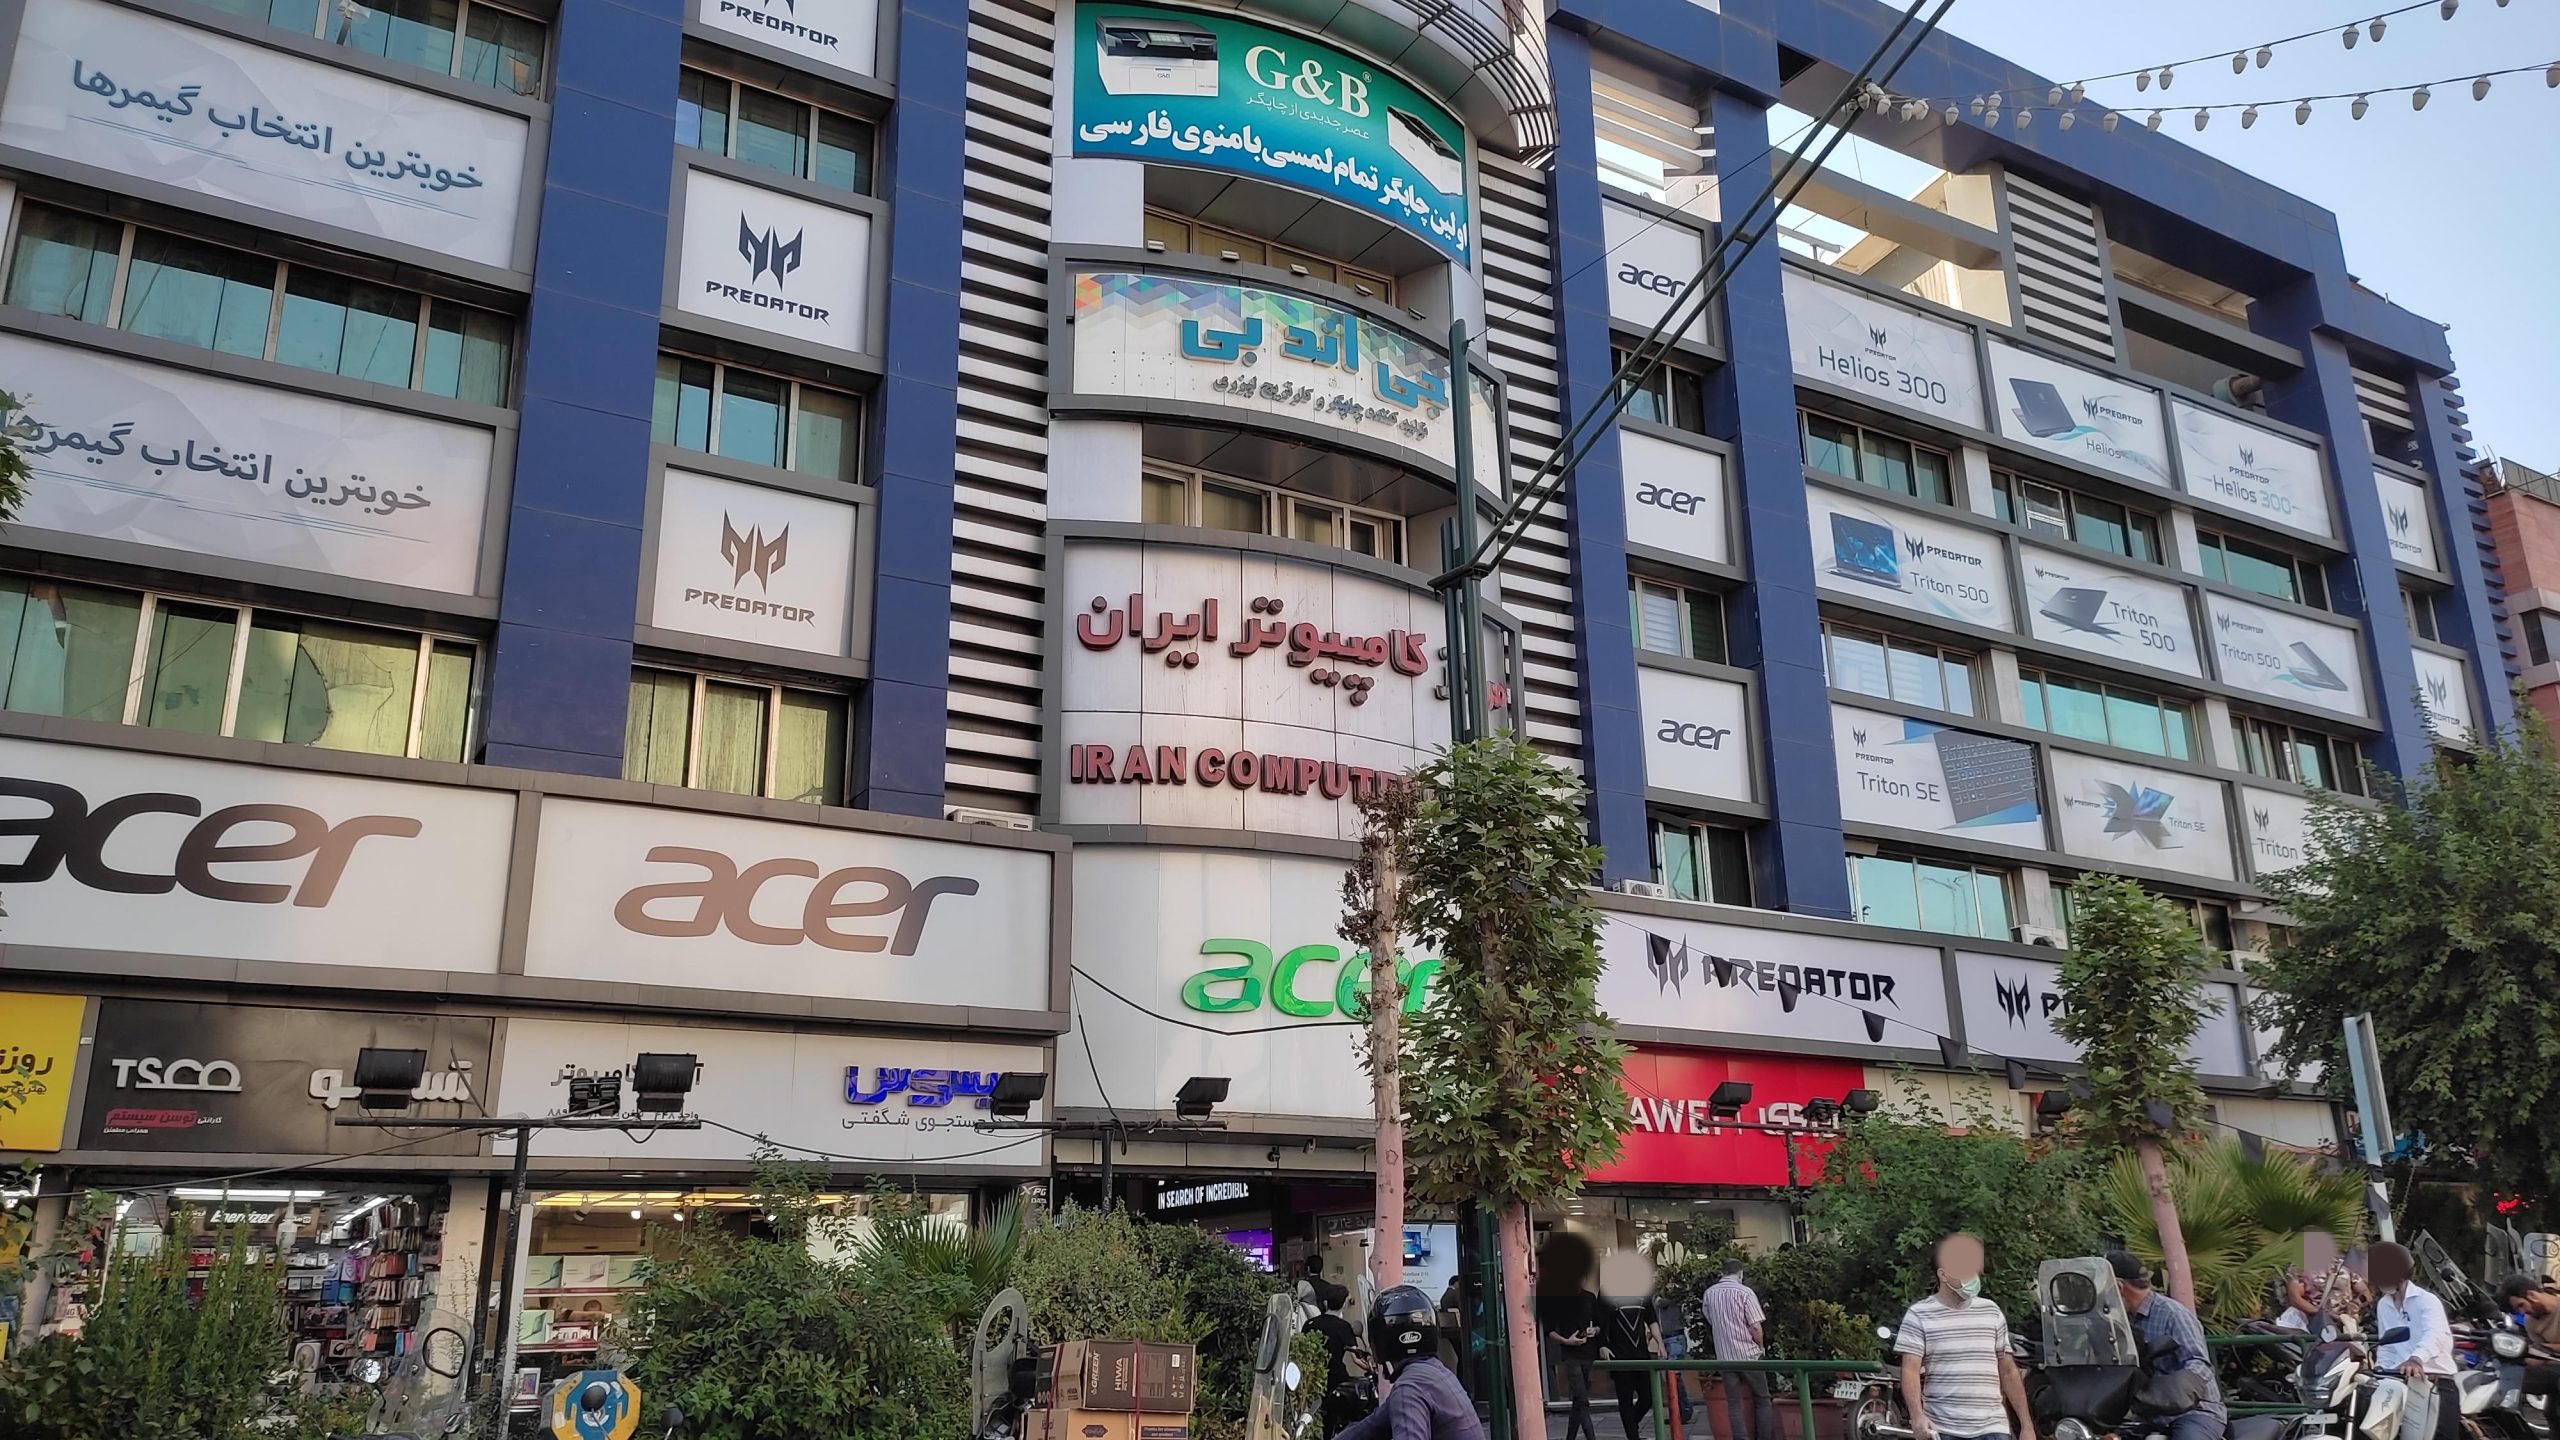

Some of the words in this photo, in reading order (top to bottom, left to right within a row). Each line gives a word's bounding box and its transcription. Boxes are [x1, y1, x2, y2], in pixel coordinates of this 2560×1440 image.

[720, 0, 839, 53] PREDATOR
[73, 60, 201, 122] گیمرها
[1246, 92, 1288, 115] چاپگر
[208, 107, 332, 154] انتخاب
[1080, 110, 1172, 146] فارسی
[1300, 110, 1341, 131] جدیدی
[1342, 126, 1370, 139] عصر
[1378, 176, 1429, 227] چاپگر
[1430, 209, 1467, 250] اولین
[1617, 262, 1686, 298] acer
[705, 280, 831, 325] PREDATOR
[1180, 316, 1264, 368] بی
[1279, 314, 1360, 374] اند
[1865, 347, 1897, 361] PREDATOR
[1818, 346, 1890, 387] Helios
[1896, 370, 1947, 405] 300
[2099, 406, 2144, 427] PREDATOR
[141, 440, 272, 484] انتخاب
[2085, 438, 2122, 459] Helios
[2228, 465, 2270, 485] PREDATOR
[1636, 482, 1706, 515] acer
[2213, 475, 2257, 503] Helios
[2260, 490, 2292, 515] 300
[1926, 545, 1983, 568] PREDATOR
[1910, 571, 1954, 596] Triton
[1957, 583, 1989, 605] 500
[684, 588, 816, 628] PREDATOR
[2109, 601, 2158, 628] Triton
[1076, 592, 1218, 668] ایران
[2140, 630, 2175, 653] 500
[2231, 620, 2264, 634] PREDATOR
[1229, 596, 1430, 707] کامپیوتر
[2221, 643, 2255, 664] Triton
[2257, 654, 2281, 670] 500
[1657, 719, 1731, 751] acer
[1070, 743, 1187, 785] IRAN
[1854, 752, 1896, 767] PREDATOR
[1856, 771, 1910, 798] Triton
[1915, 782, 1941, 802] SE
[2168, 816, 2193, 831] Triton
[2193, 822, 2207, 832] SE
[2256, 837, 2298, 860] Triton
[613, 846, 979, 957] acer
[111, 1057, 243, 1092] TSCO
[842, 1109, 910, 1129] شگفتی
[1158, 1192, 1165, 1210] IN
[1166, 1188, 1193, 1208] SEARCH
[1194, 1186, 1204, 1204] OF
[1205, 1182, 1249, 1203] INCREDIBLE
[1114, 1357, 1123, 1391] HIWA
